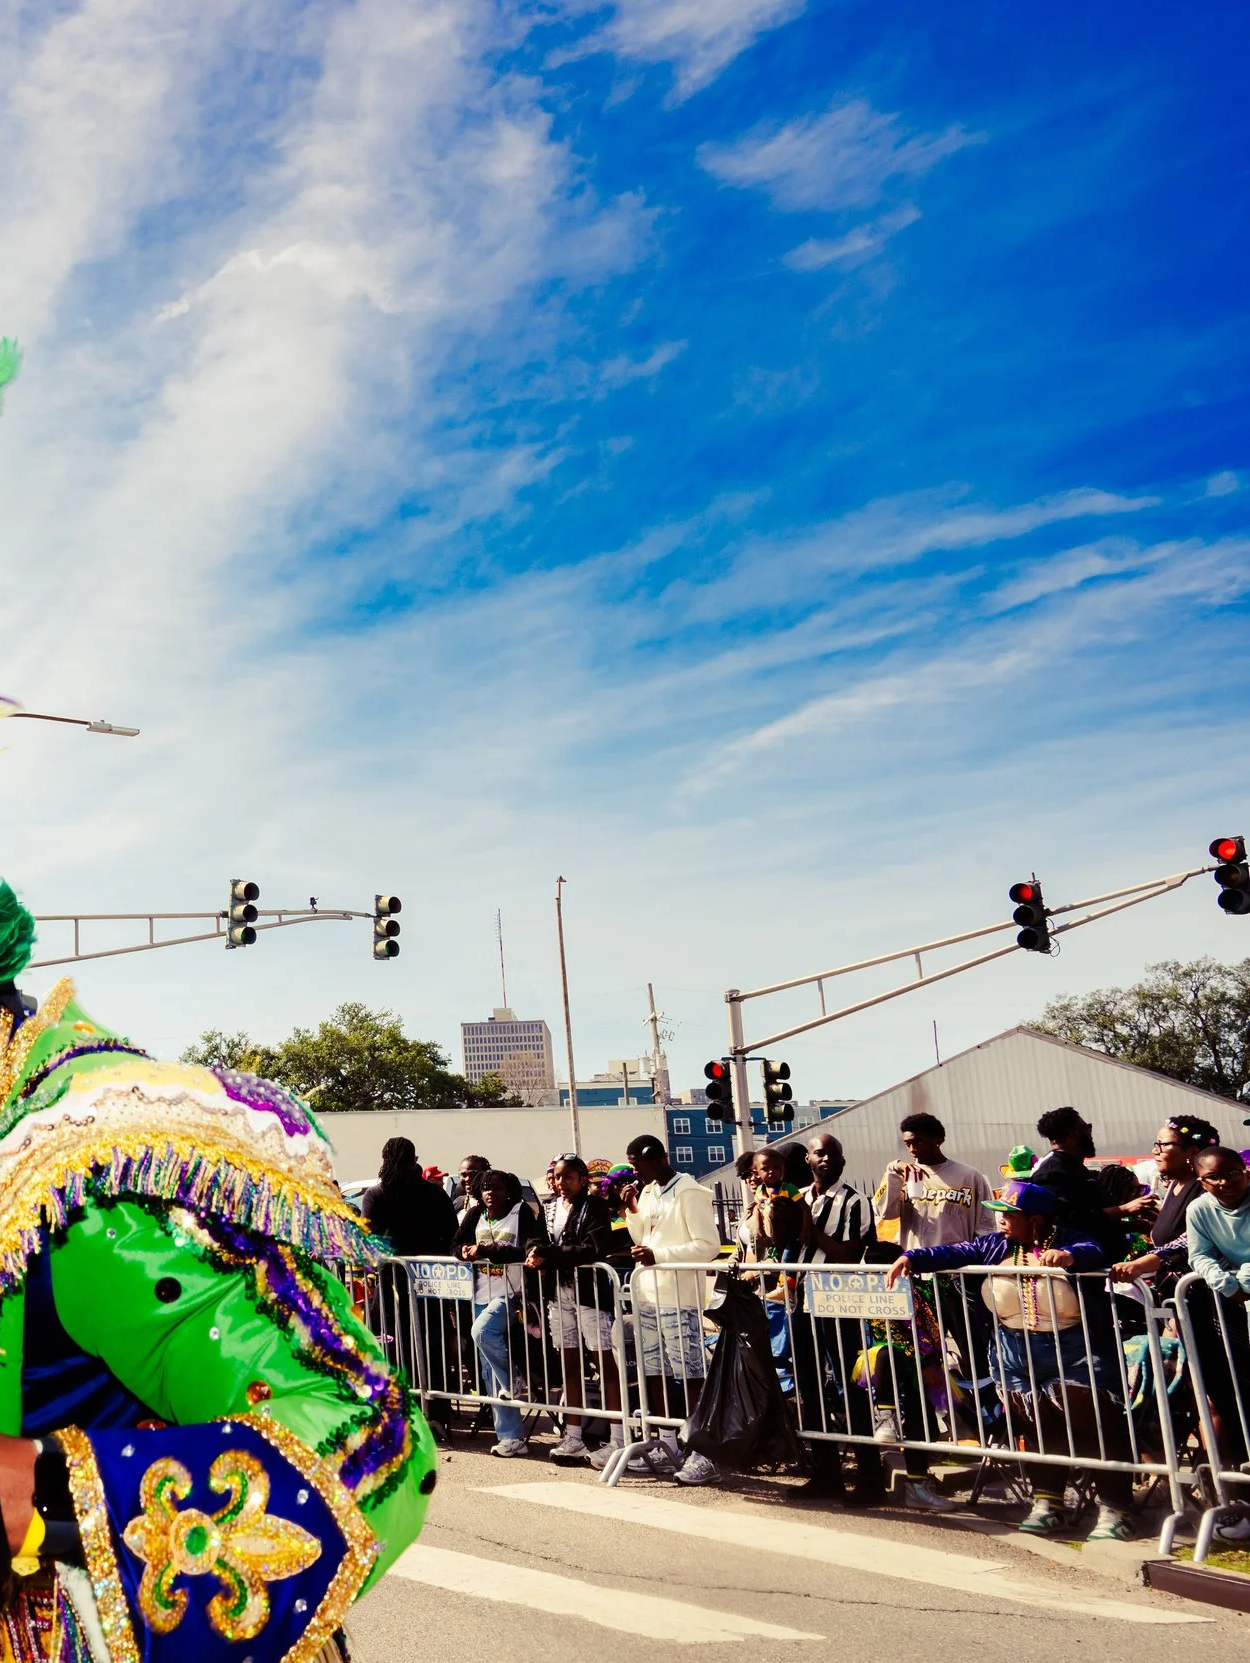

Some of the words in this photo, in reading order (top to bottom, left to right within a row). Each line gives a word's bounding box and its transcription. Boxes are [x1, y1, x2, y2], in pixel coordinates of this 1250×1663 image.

[905, 1187, 972, 1206] epark
[825, 1294, 865, 1303] POLICE
[869, 1295, 894, 1304] LINE
[818, 1304, 835, 1313] DO
[839, 1305, 863, 1314] NOT
[868, 1305, 906, 1315] CROSS
